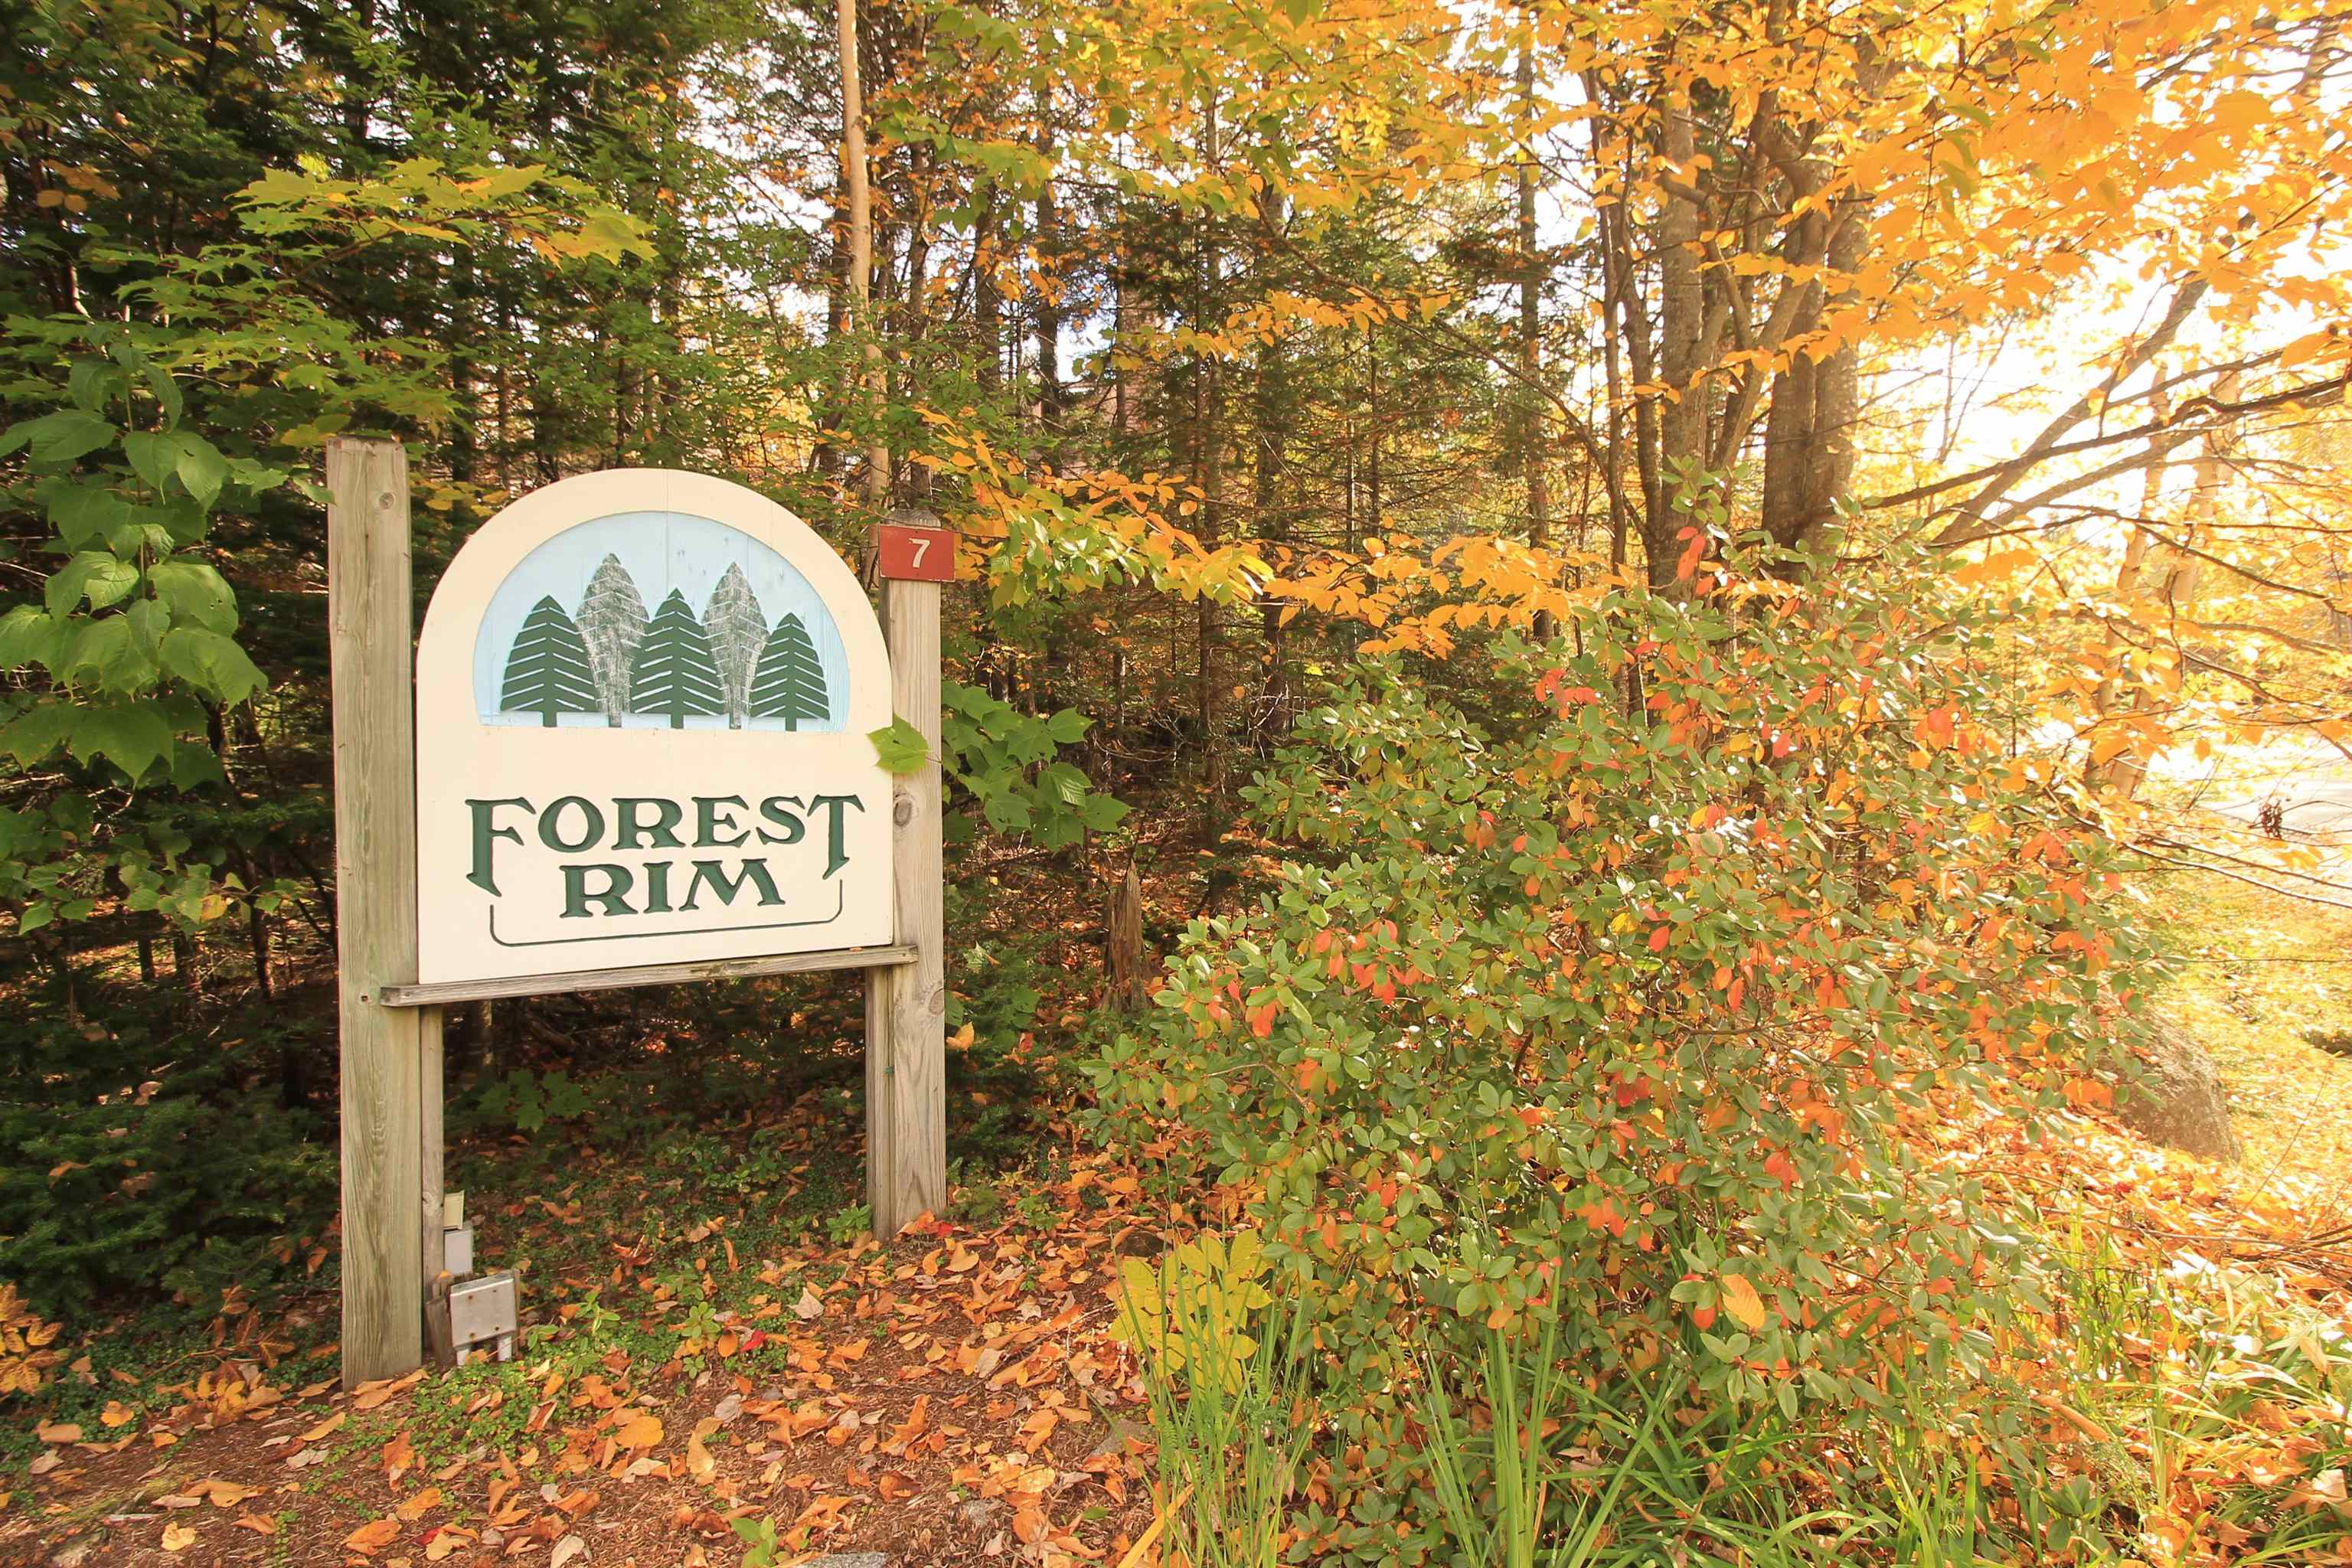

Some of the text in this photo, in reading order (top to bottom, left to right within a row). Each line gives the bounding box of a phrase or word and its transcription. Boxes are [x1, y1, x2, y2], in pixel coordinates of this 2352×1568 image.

[908, 537, 930, 568] 7
[465, 794, 866, 897] FOREST
[559, 858, 786, 918] RIM
